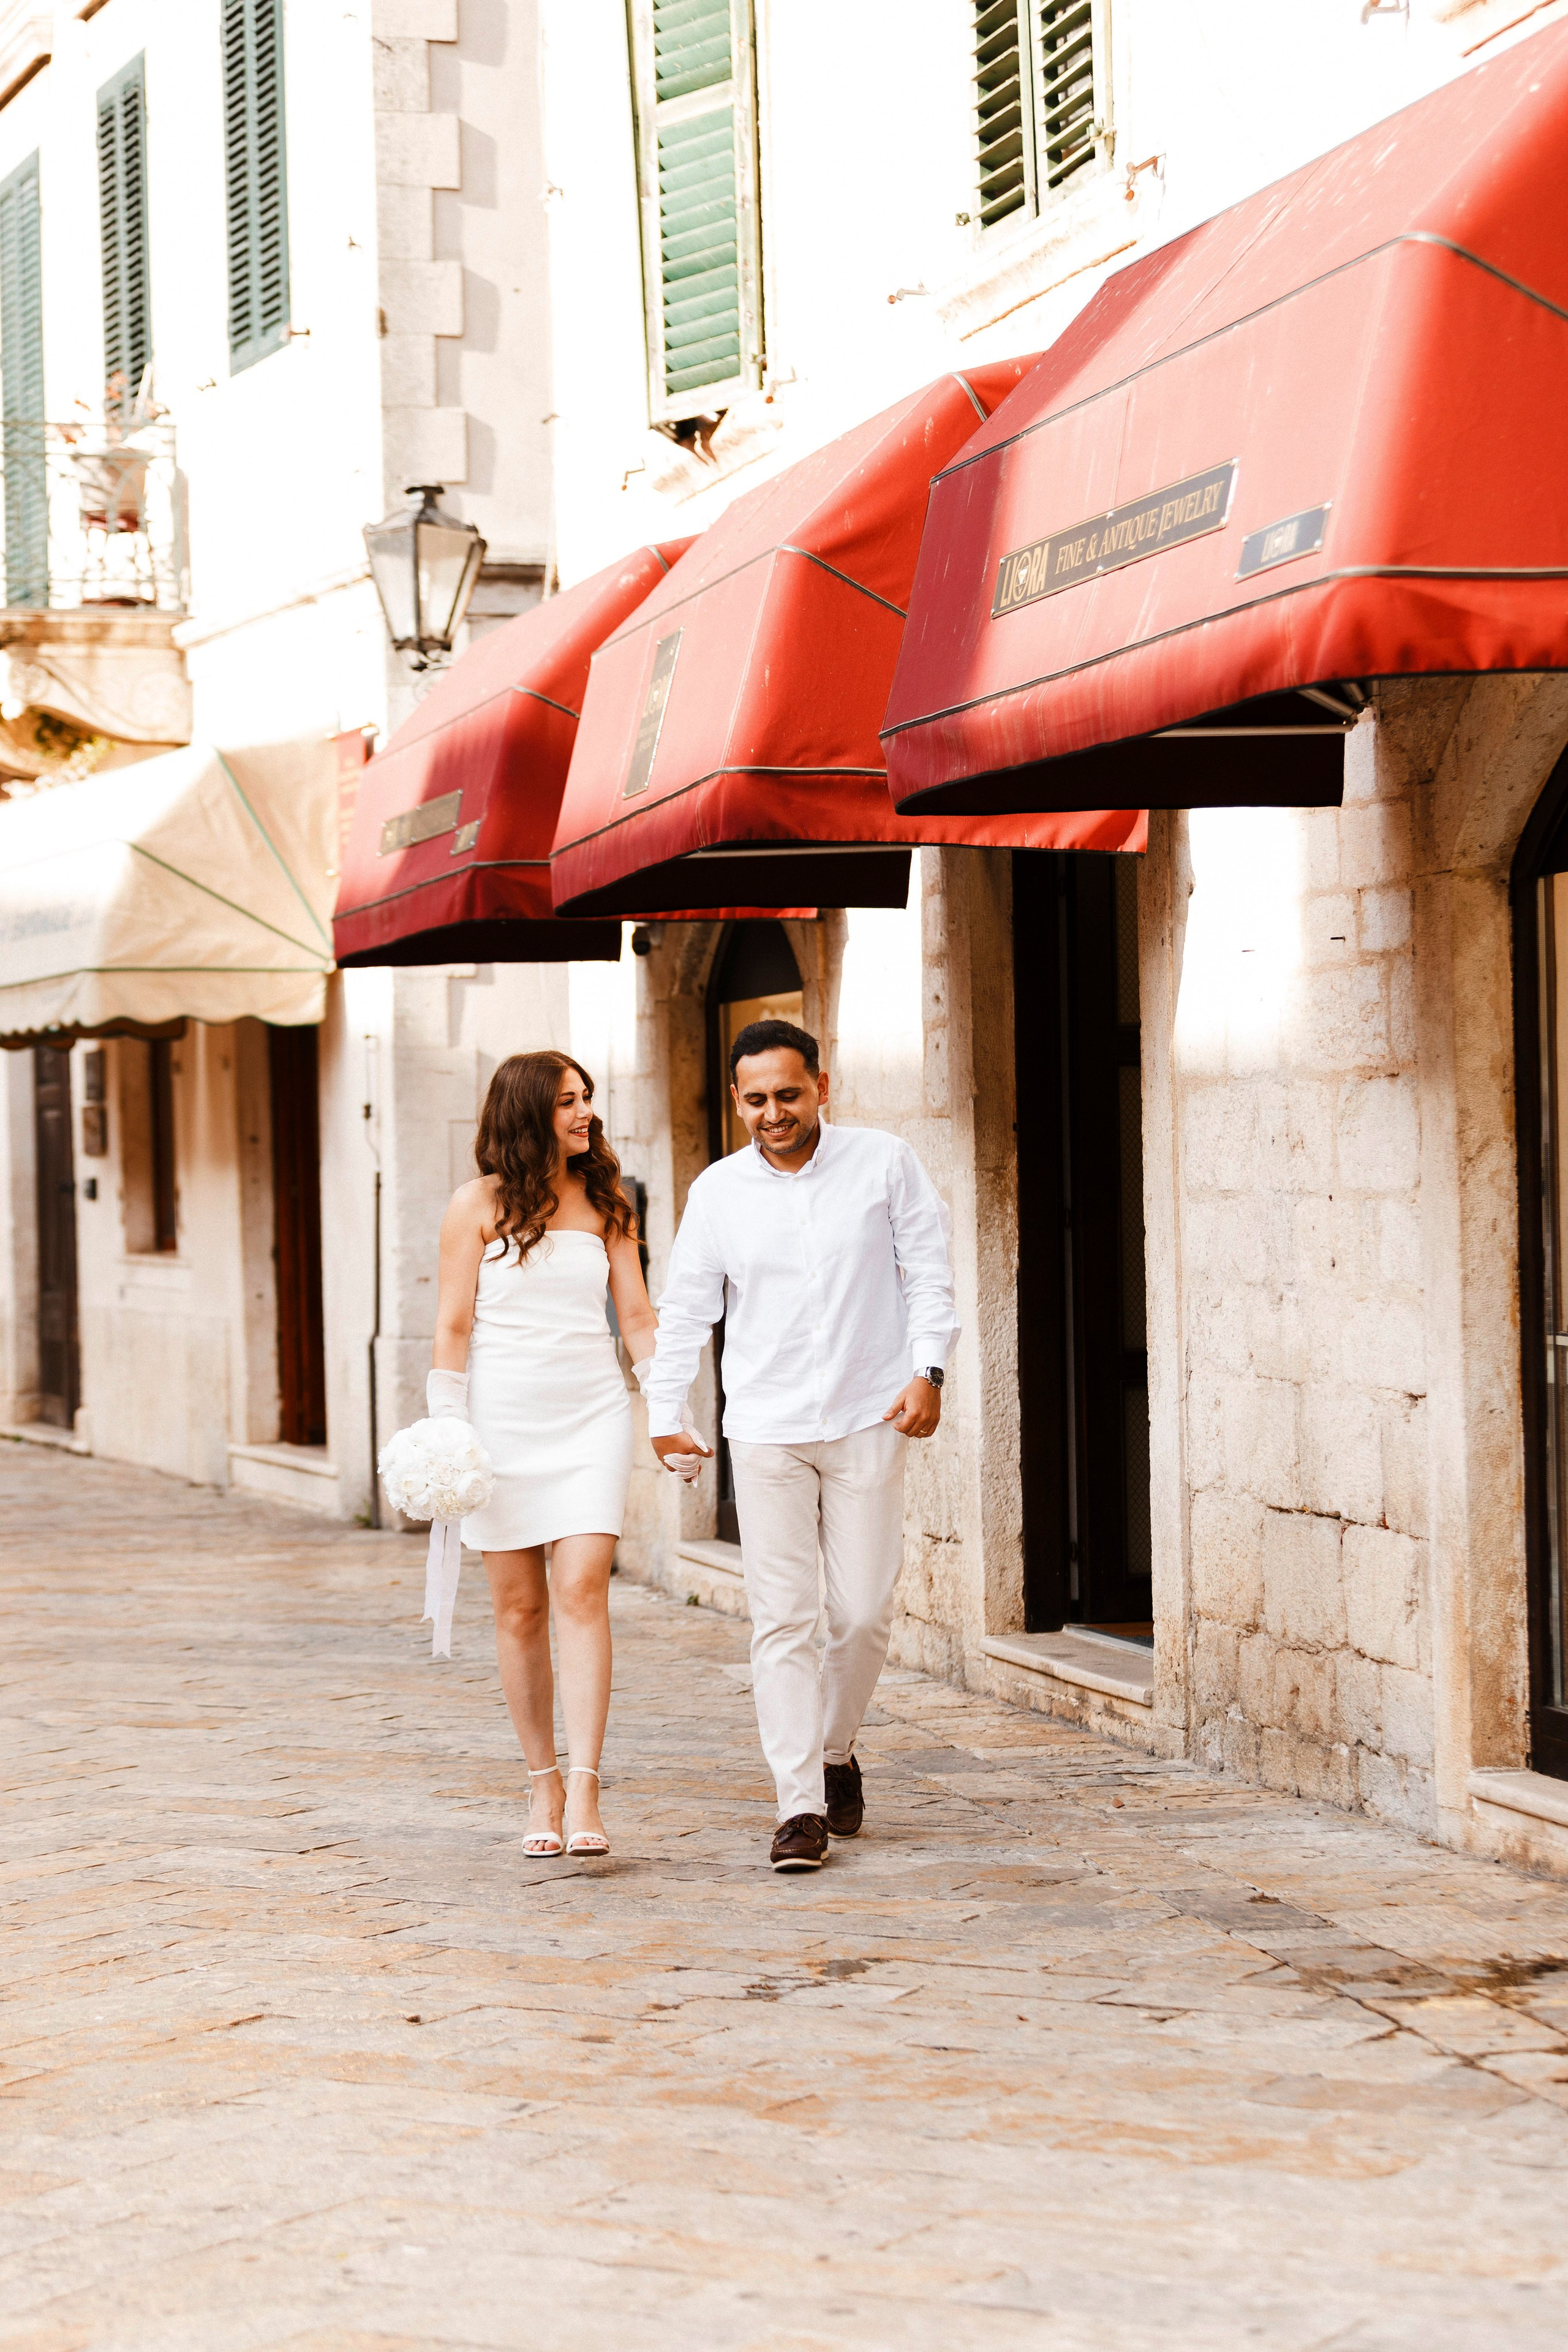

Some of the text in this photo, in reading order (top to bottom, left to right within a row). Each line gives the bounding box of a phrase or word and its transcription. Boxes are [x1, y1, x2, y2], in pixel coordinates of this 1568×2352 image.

[1000, 480, 1226, 608] LIORA FINE & ANTIQUE JEWELRY
